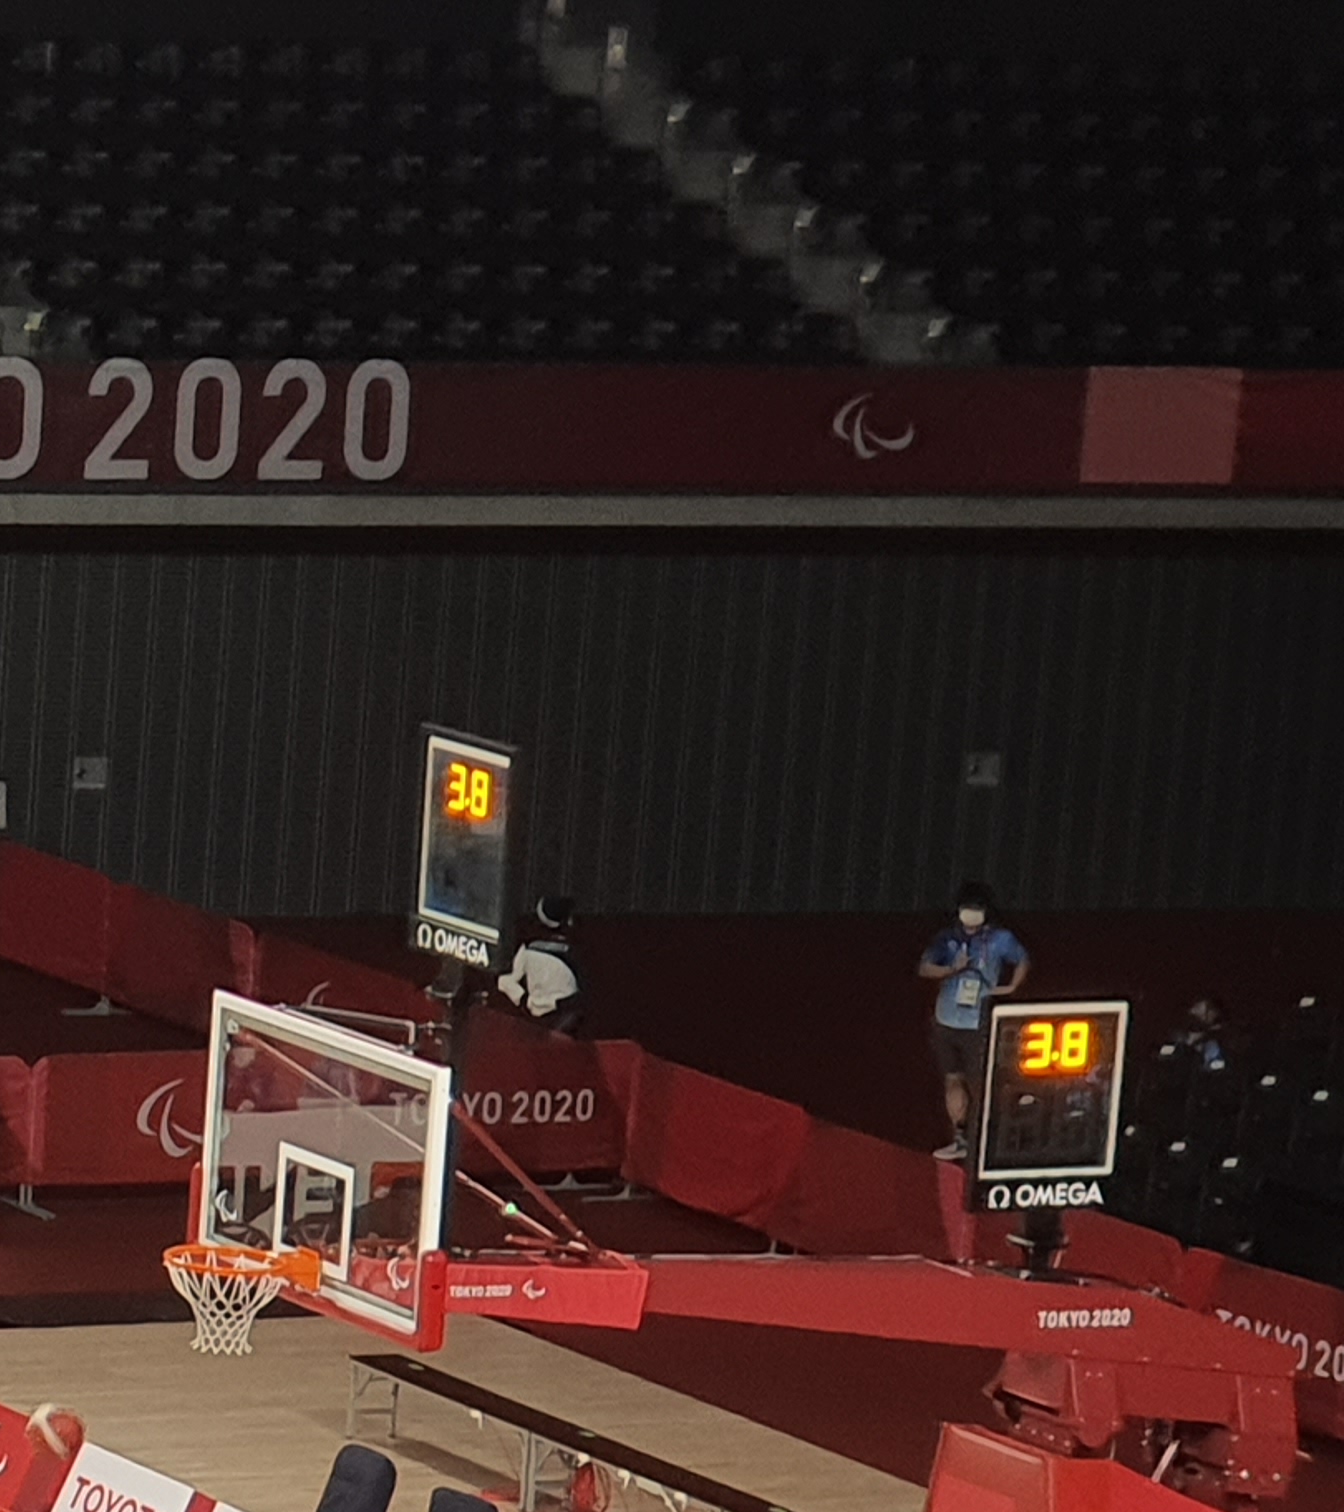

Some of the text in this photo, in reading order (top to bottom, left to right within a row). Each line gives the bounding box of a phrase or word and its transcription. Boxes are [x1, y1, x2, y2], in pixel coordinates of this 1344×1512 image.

[83, 357, 411, 482] 2020
[434, 929, 490, 967] OMEGA
[390, 1088, 595, 1126] TYO 2020
[1015, 1181, 1105, 1207] OMEGA
[1037, 1308, 1132, 1329] TOKYO 2020
